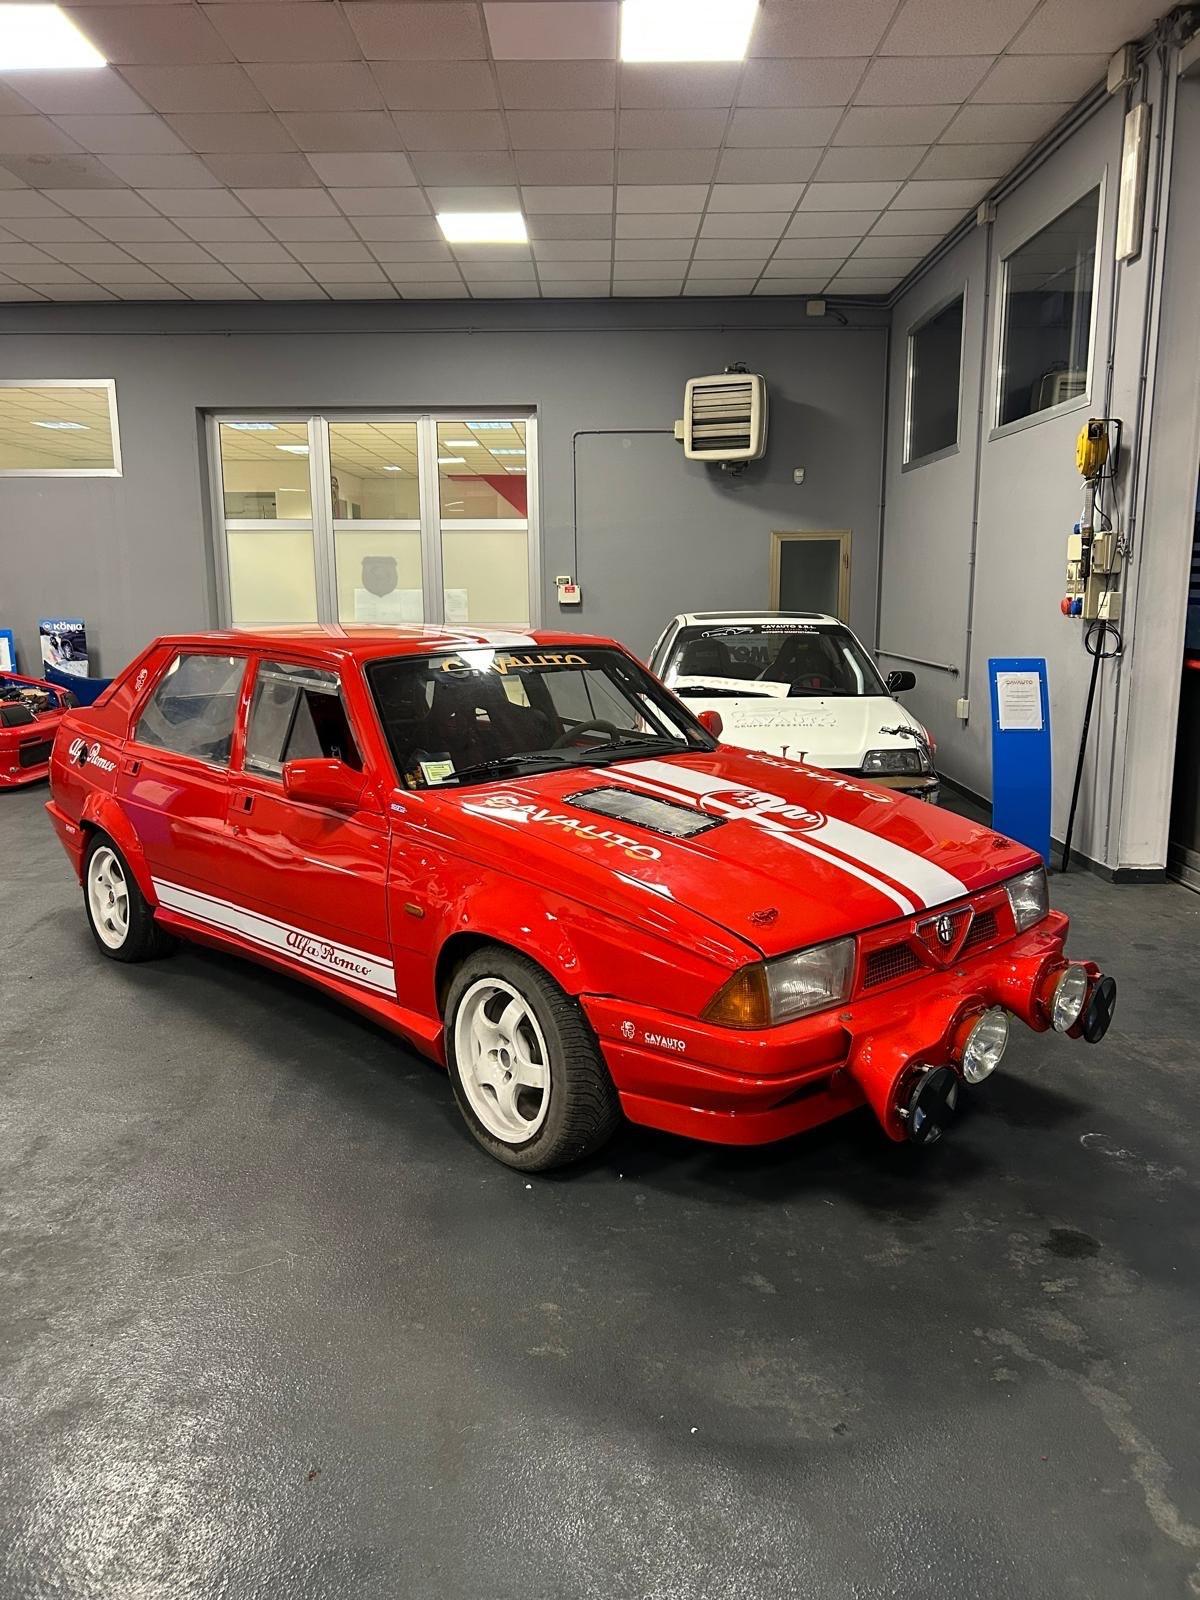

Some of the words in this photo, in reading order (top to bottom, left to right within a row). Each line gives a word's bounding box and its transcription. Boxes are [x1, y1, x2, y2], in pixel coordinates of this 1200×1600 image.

[53, 621, 83, 631] KÖNIG
[440, 653, 592, 678] CVAUTO
[69, 738, 90, 768] Alf
[87, 743, 117, 772] Romeo
[482, 796, 662, 862] CAVAUTO
[286, 931, 320, 957] Alfa
[320, 942, 371, 975] Romeo
[644, 1032, 686, 1050] CAVAUTO
